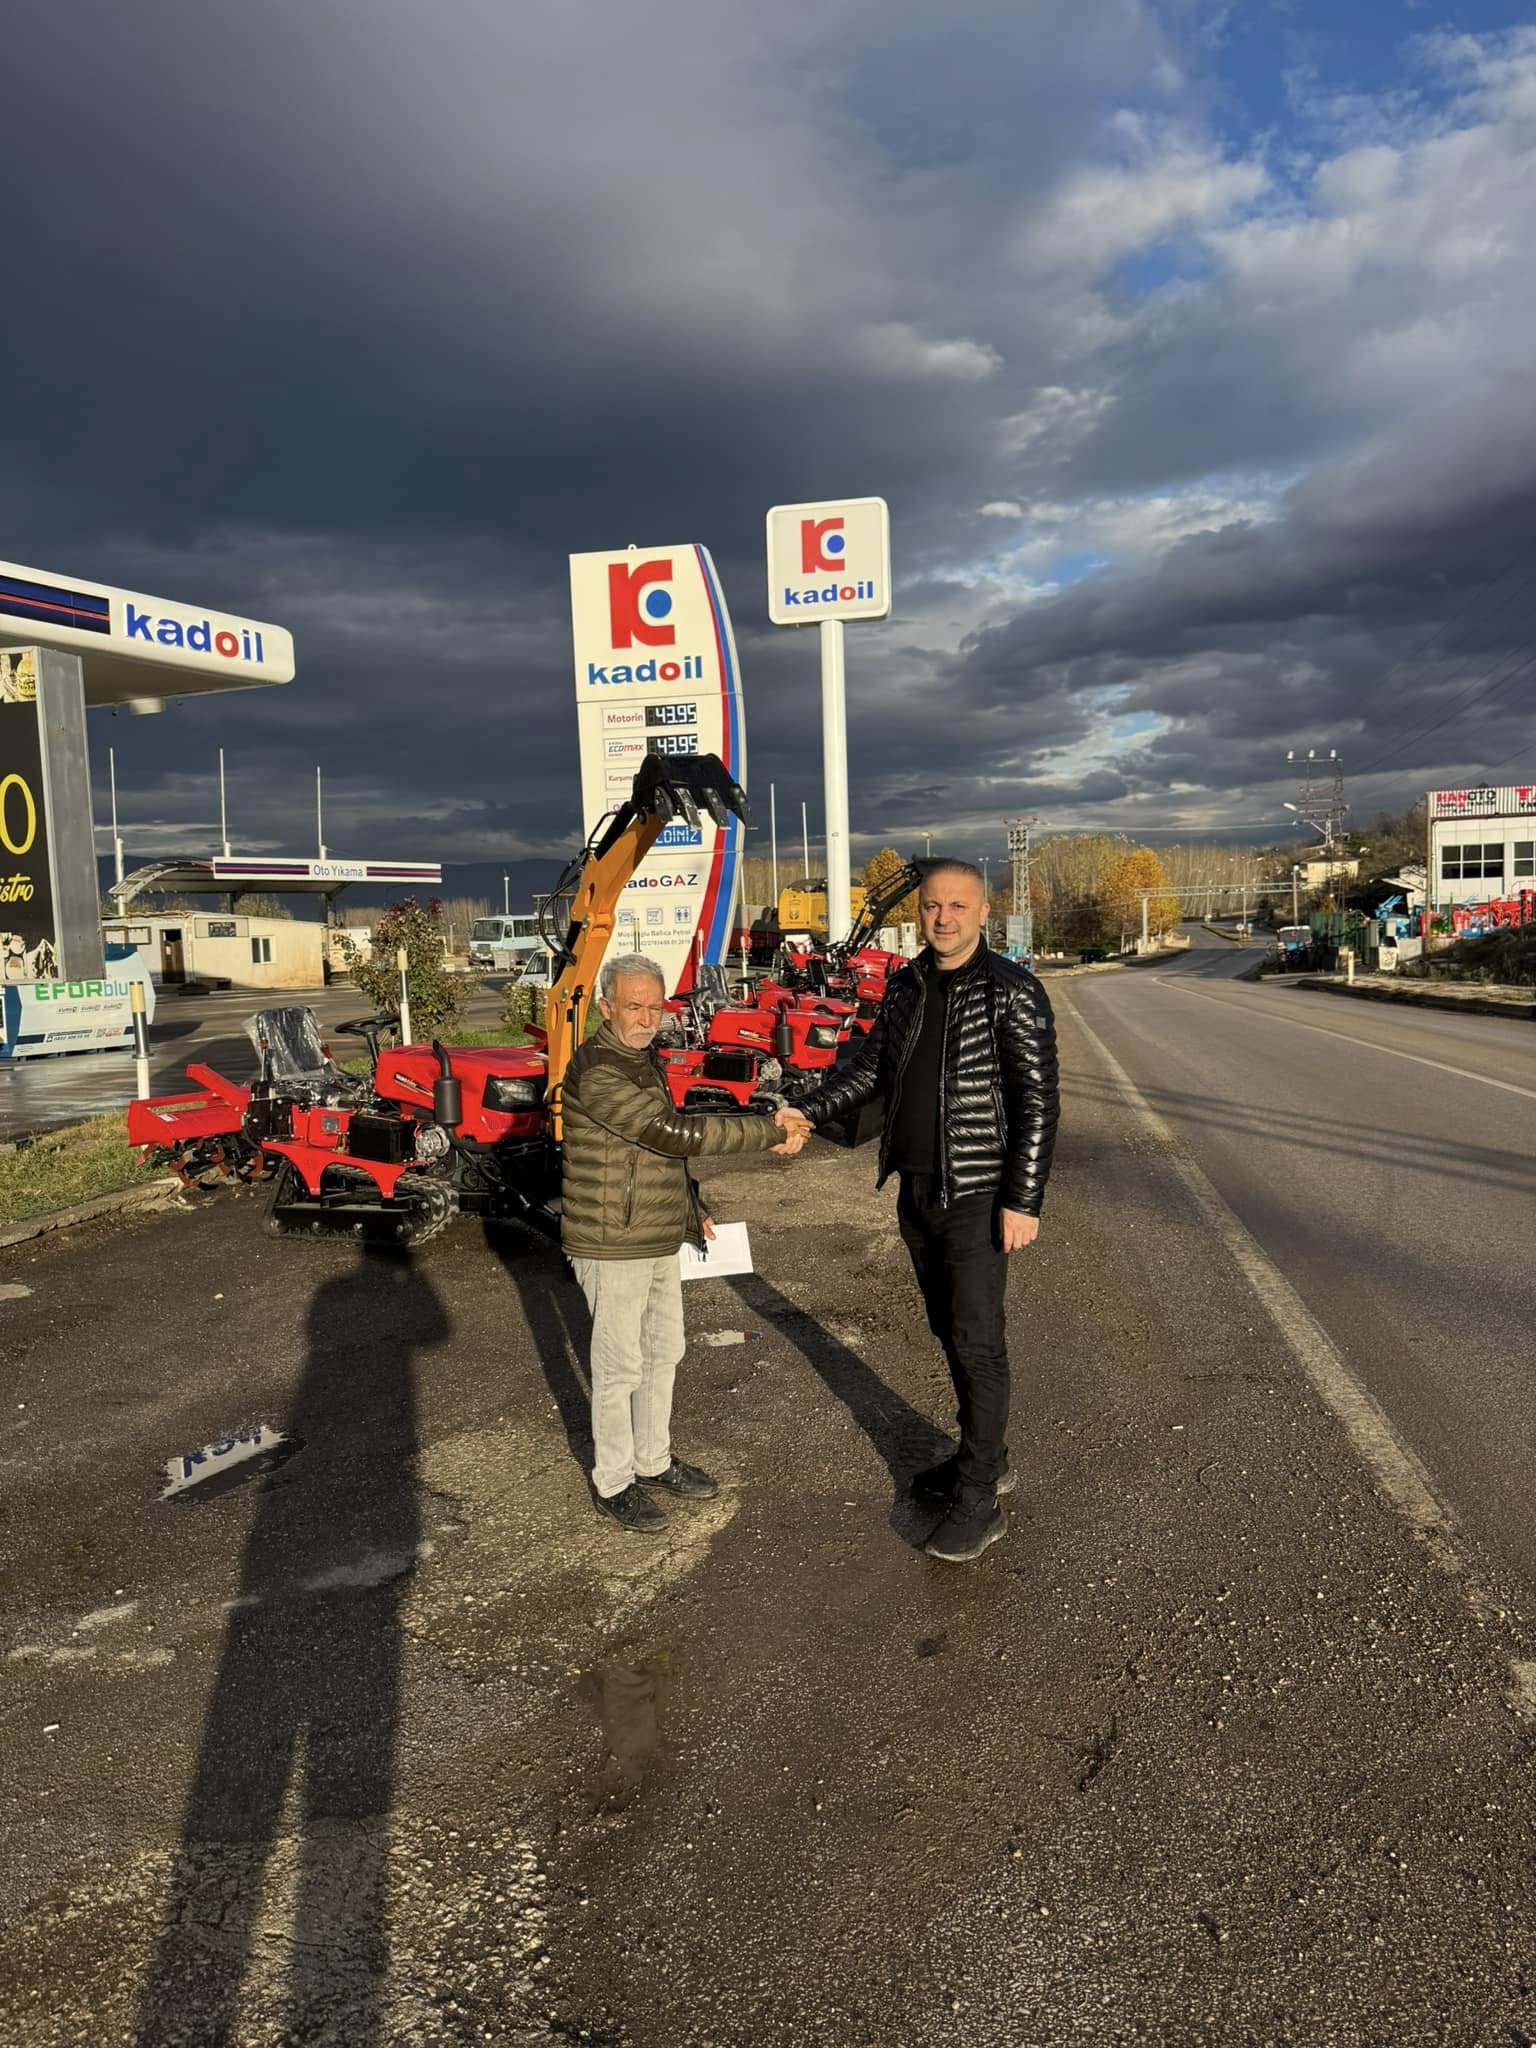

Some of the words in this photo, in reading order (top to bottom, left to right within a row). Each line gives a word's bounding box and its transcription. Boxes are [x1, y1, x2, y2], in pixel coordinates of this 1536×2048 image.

[785, 581, 873, 605] kadoil
[126, 603, 263, 662] kadoil
[588, 655, 703, 685] kadoil
[607, 713, 643, 723] Motorin
[313, 864, 329, 876] Oto
